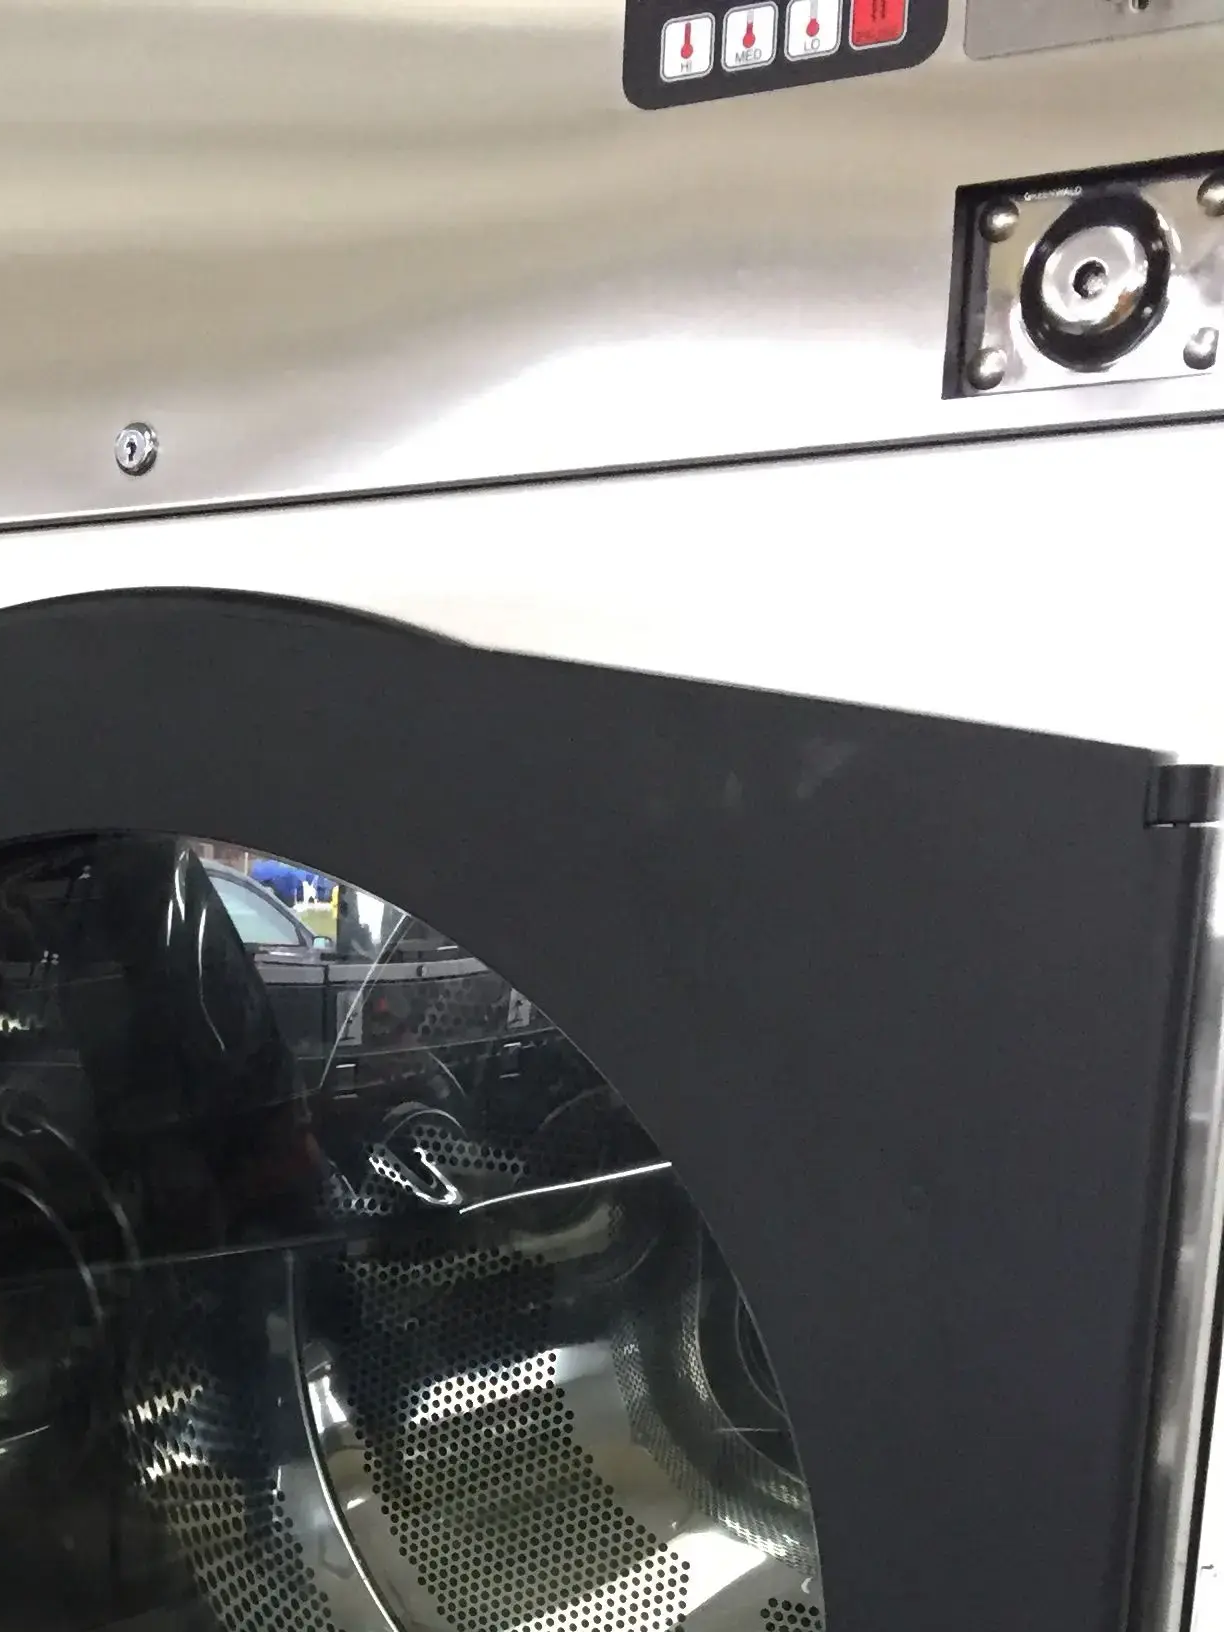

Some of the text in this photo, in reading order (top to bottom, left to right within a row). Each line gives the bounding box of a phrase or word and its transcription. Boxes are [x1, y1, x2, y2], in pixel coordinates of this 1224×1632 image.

[804, 38, 821, 51] LO
[734, 48, 763, 64] MED
[680, 61, 693, 73] HI
